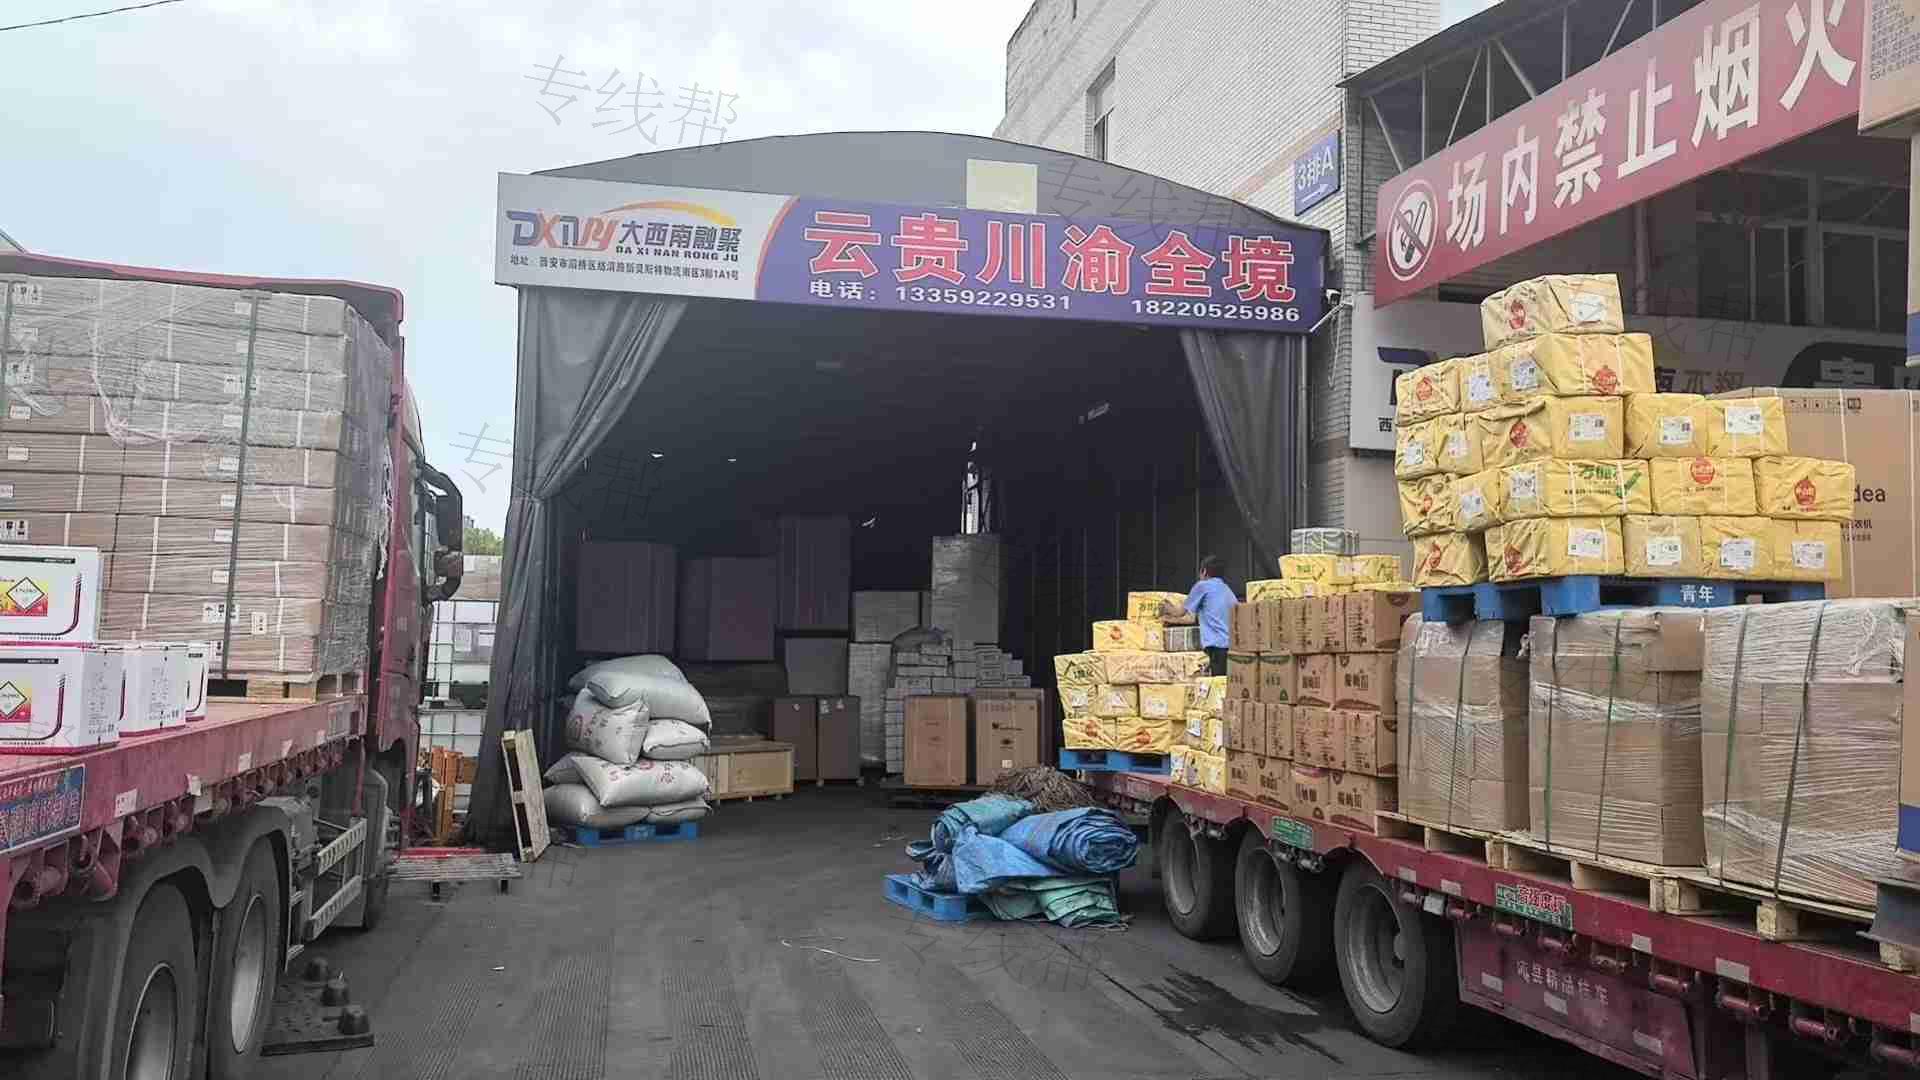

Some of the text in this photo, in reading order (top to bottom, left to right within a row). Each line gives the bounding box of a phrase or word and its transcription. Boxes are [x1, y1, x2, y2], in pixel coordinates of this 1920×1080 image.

[1445, 0, 1857, 252] 场内禁止烟火
[1296, 144, 1335, 191] 3排A
[615, 245, 740, 263] DA XI NAN RONG JU
[618, 220, 744, 254] 大西南融聚
[804, 210, 1298, 303] 云贵川渝全境
[895, 286, 1072, 310] 13359229531
[1130, 299, 1300, 323] 18220525986
[1377, 416, 1393, 432] 西
[1679, 584, 1715, 604] 青年
